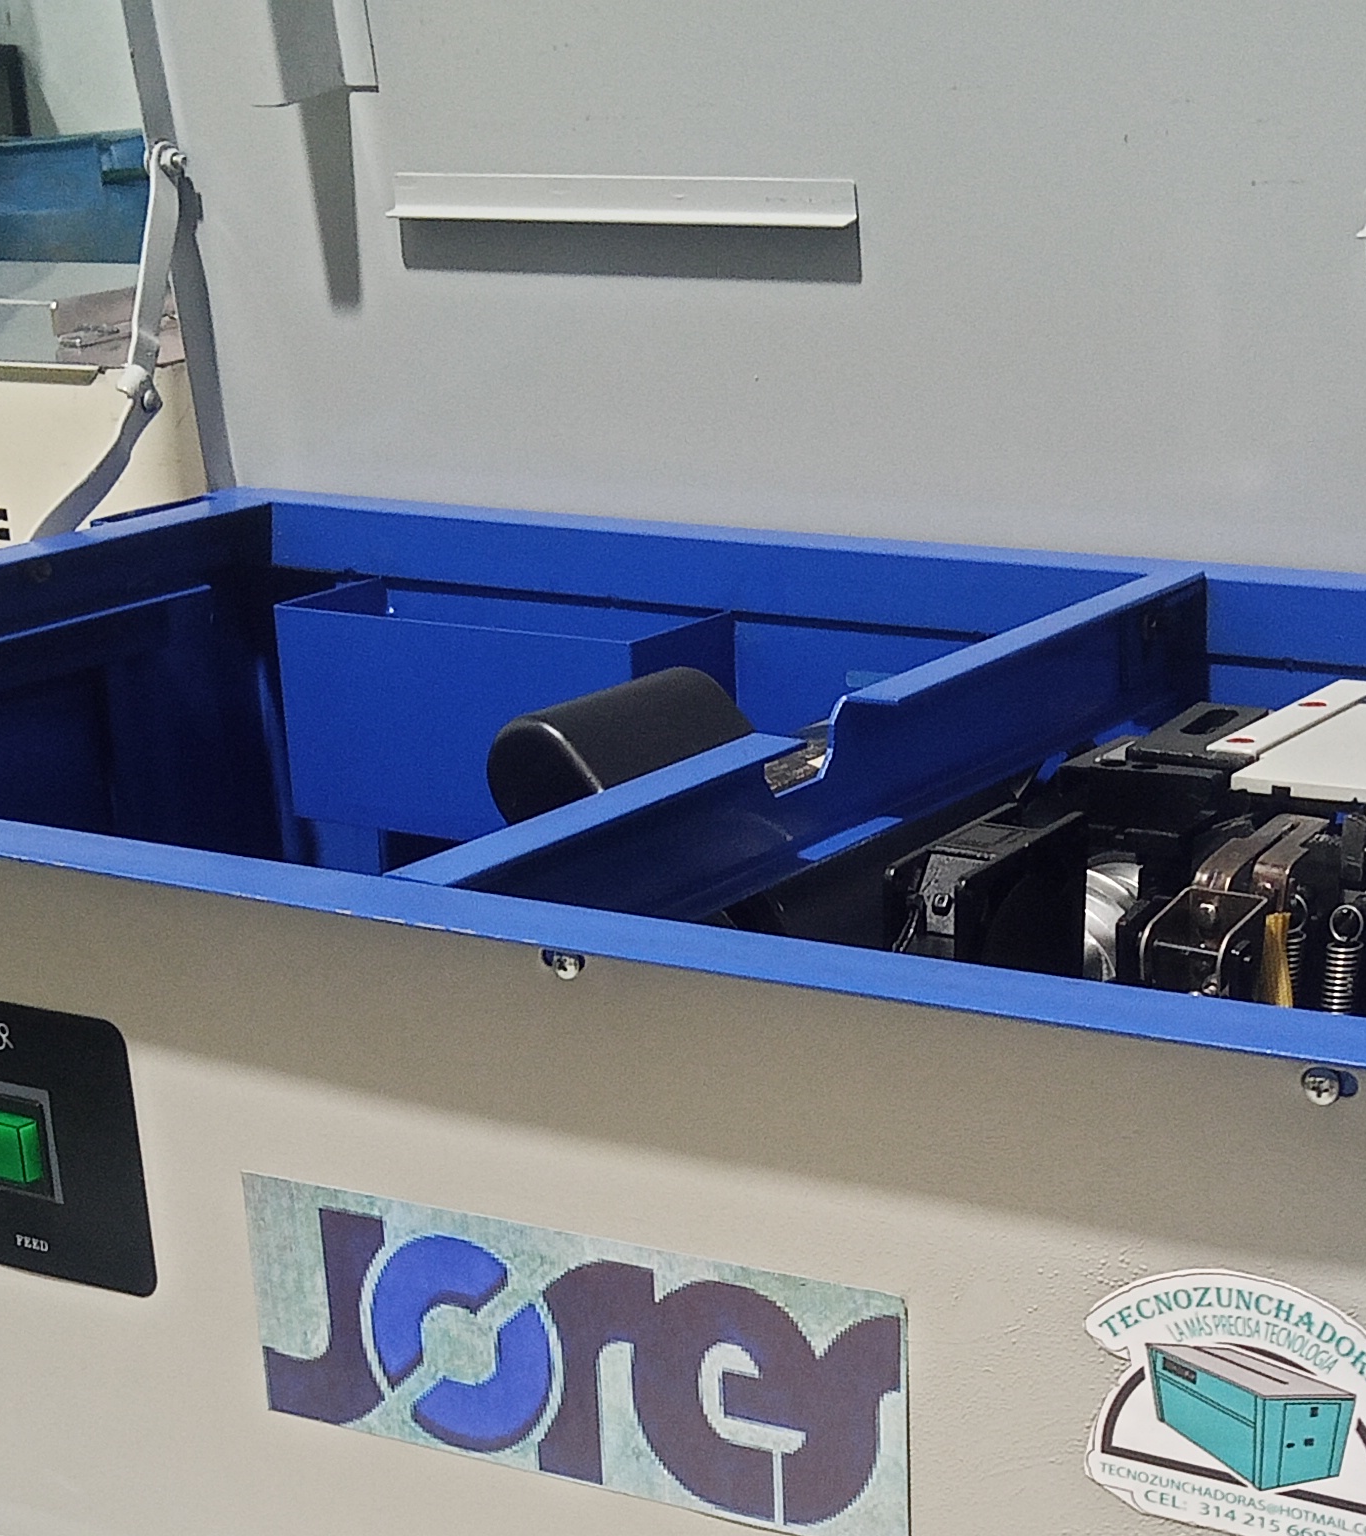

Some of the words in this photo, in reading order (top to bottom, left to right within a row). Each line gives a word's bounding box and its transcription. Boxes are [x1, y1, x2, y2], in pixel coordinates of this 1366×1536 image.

[15, 1234, 49, 1252] FEED
[1166, 1322, 1187, 1342] LA
[1212, 1314, 1261, 1338] PRECISA
[1199, 1503, 1236, 1522] 314
[1242, 1514, 1280, 1533] 215
